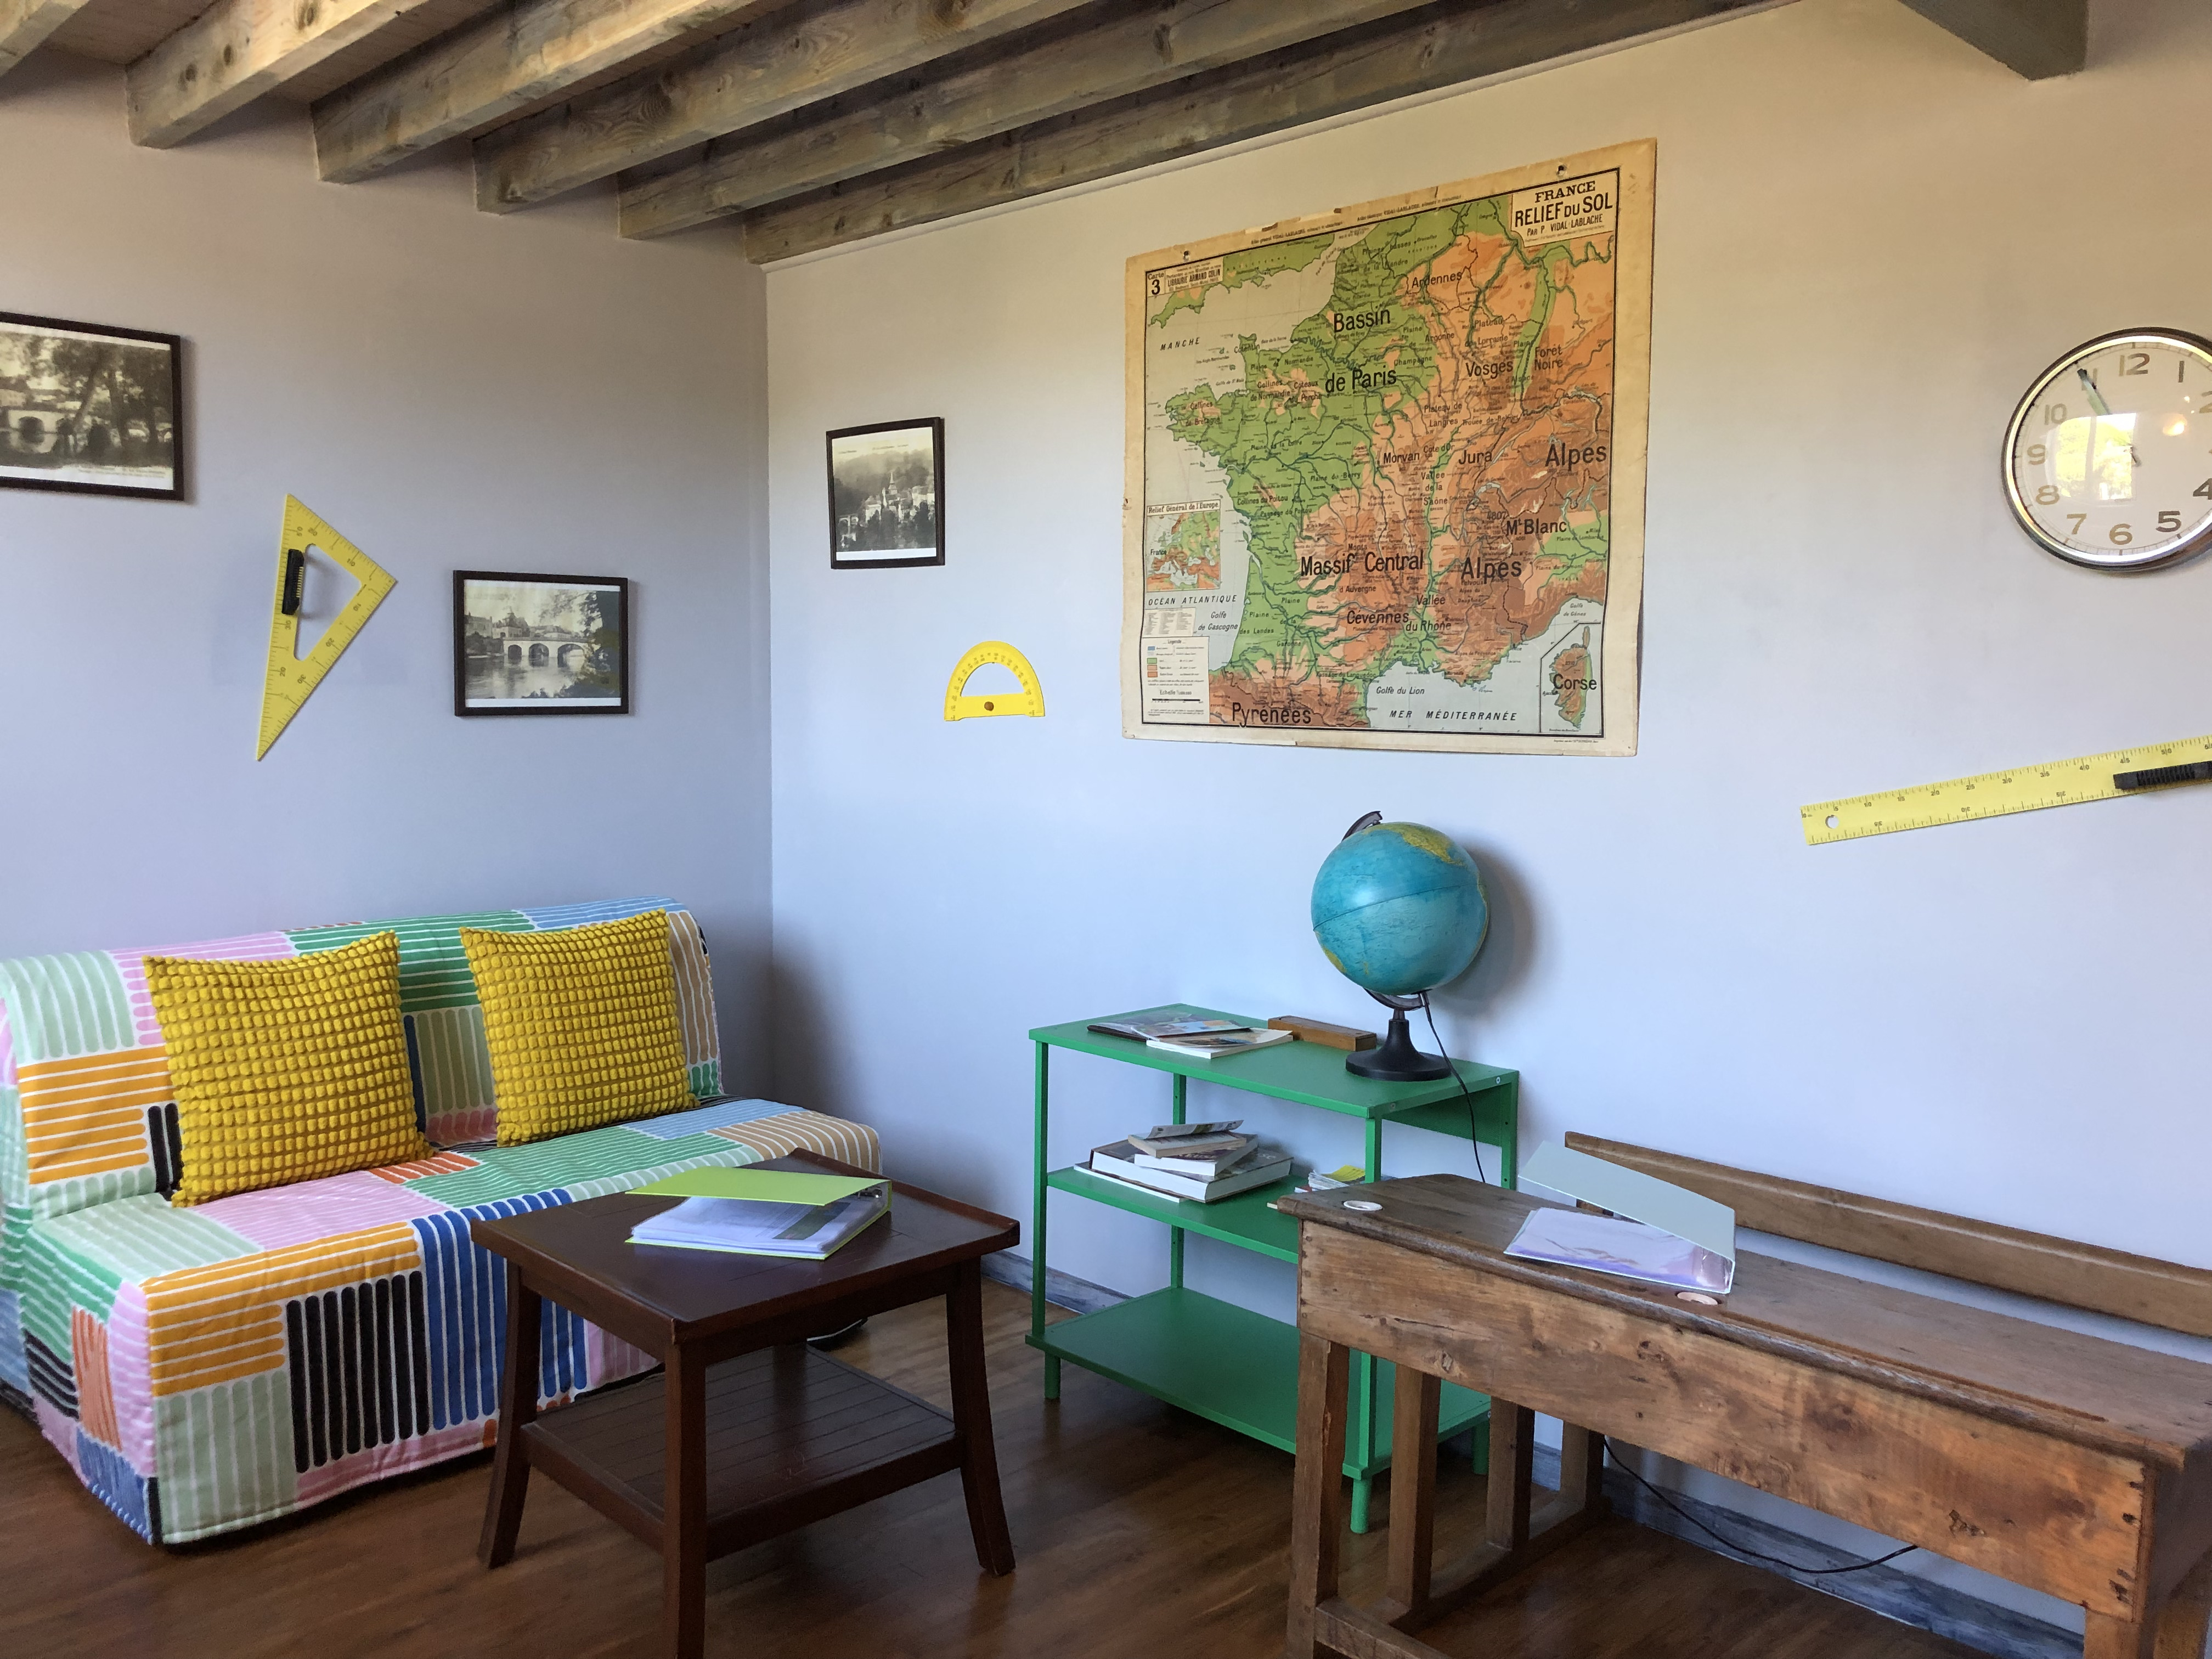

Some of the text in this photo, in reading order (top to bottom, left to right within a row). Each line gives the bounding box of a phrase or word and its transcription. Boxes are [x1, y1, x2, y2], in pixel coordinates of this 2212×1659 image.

[1535, 180, 1595, 203] FRANCE
[1515, 192, 1613, 227] RELIEF DU SOL
[1550, 221, 1567, 232] VIDAL
[1571, 214, 1603, 228] LABLACHE
[1167, 275, 1188, 286] LIBRAIRIE
[1189, 272, 1207, 282] ARMAND
[1208, 268, 1221, 278] COLIN
[1412, 271, 1462, 289] Ardennes
[1151, 279, 1160, 295] 3
[1334, 306, 1391, 332] Bassin
[1474, 318, 1504, 328] Plateau
[1160, 337, 1200, 351] MANCHE
[1425, 331, 1455, 343] Argonne
[1477, 336, 1508, 346] Lorraine
[1234, 344, 1260, 353] Cotentin
[1284, 357, 1313, 365] Normandie
[1393, 356, 1432, 366] Champagne
[1534, 358, 1563, 371] Noire
[2119, 353, 2150, 377] 12
[1465, 360, 1513, 380] Vosges
[2178, 360, 2185, 383] 1
[1257, 380, 1283, 389] Collines
[1325, 365, 1397, 393] de Paris
[1250, 390, 1290, 402] de Normandie
[1190, 402, 1213, 410] Collines
[1424, 402, 1463, 413] Plateau de
[2044, 403, 2067, 425] 10
[1194, 416, 1220, 426] Bretagne
[1429, 419, 1459, 428] Langres
[1383, 452, 1420, 464] Morvan
[1458, 450, 1493, 465] Jura
[1545, 442, 1607, 472] Alpes
[2027, 444, 2046, 465] 9
[2035, 484, 2060, 505] 8
[2192, 477, 2212, 500] 4
[1487, 511, 1506, 520] 4807
[2155, 510, 2182, 533] 5
[1524, 518, 1567, 535] Blanc
[2066, 513, 2087, 535] 7
[2109, 523, 2133, 545] 6
[1301, 549, 1424, 577] Massif Central
[1460, 556, 1522, 584] Alpes
[1182, 594, 1237, 604] ATLANTIQUE
[1347, 610, 1409, 624] Cévennes
[1207, 623, 1238, 632] Gascogne
[1406, 620, 1418, 631] du
[1553, 673, 1597, 690] Corse
[1376, 686, 1395, 695] Golfe
[1409, 686, 1425, 695] Lion
[1232, 702, 1311, 728] Pyrénées
[1389, 709, 1517, 721] MER MÉDITERRANÉE
